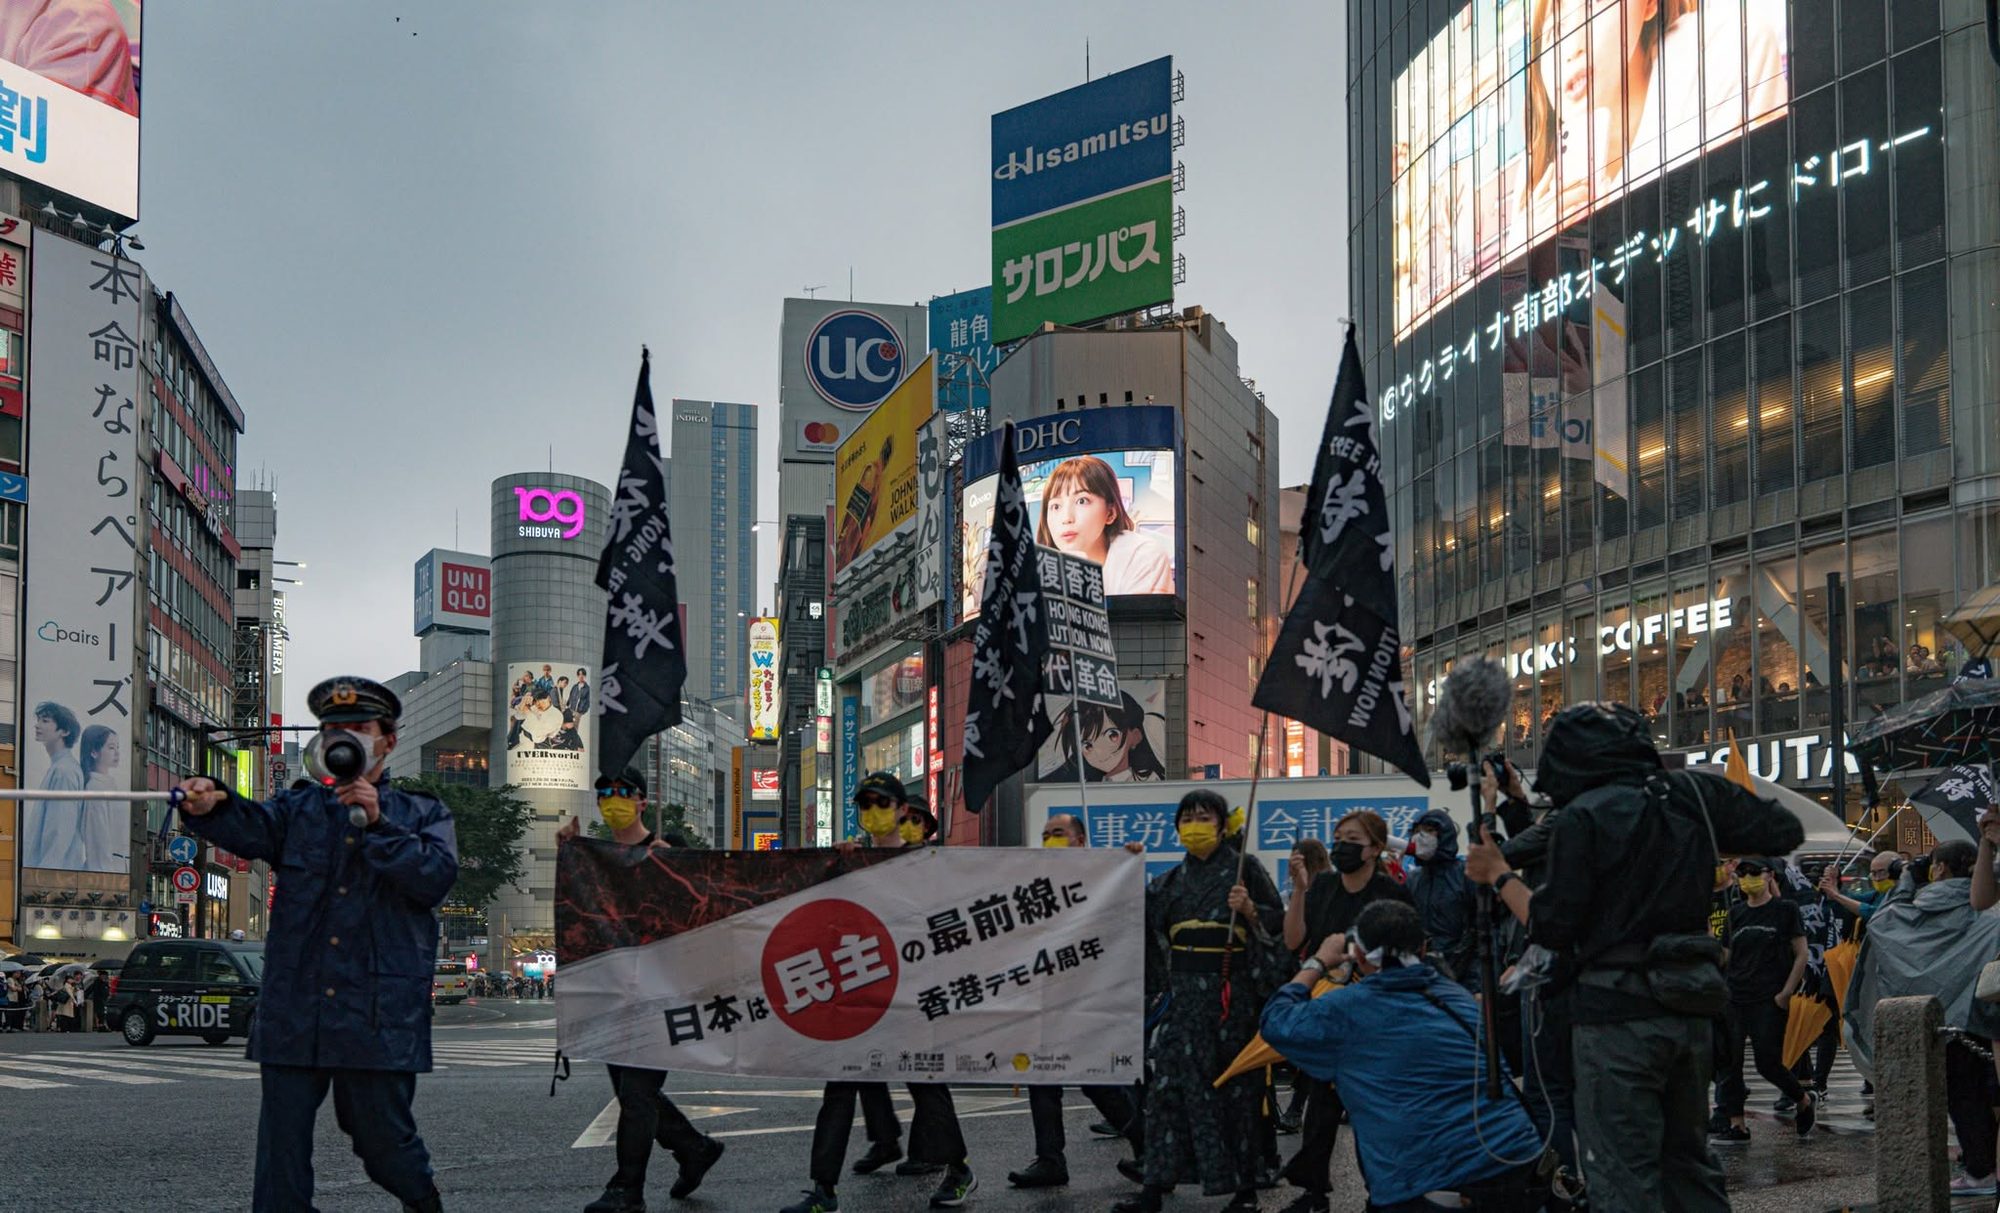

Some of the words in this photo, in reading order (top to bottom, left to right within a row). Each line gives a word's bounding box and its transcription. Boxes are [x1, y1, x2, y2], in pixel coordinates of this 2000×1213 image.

[994, 113, 1168, 180] Hisamitsu
[1002, 220, 1160, 304] サロンパス
[1018, 419, 1081, 453] DHC
[88, 257, 141, 718] 本命ならペアーズ
[514, 487, 585, 540] 109
[890, 494, 918, 524] WALK
[518, 526, 561, 539] SHIBUYA
[447, 569, 483, 591] UNI
[447, 590, 487, 611] QLO
[1048, 600, 1082, 626] HONG
[1081, 609, 1108, 634] KONG
[56, 627, 99, 647] pairs
[1600, 597, 1734, 655] COFFEE
[1089, 633, 1113, 655] NOW
[1261, 805, 1421, 846] 会計務
[206, 872, 229, 900] LUSH
[917, 937, 1105, 1022] 香港デモ4周年
[1115, 1055, 1133, 1066] HK
